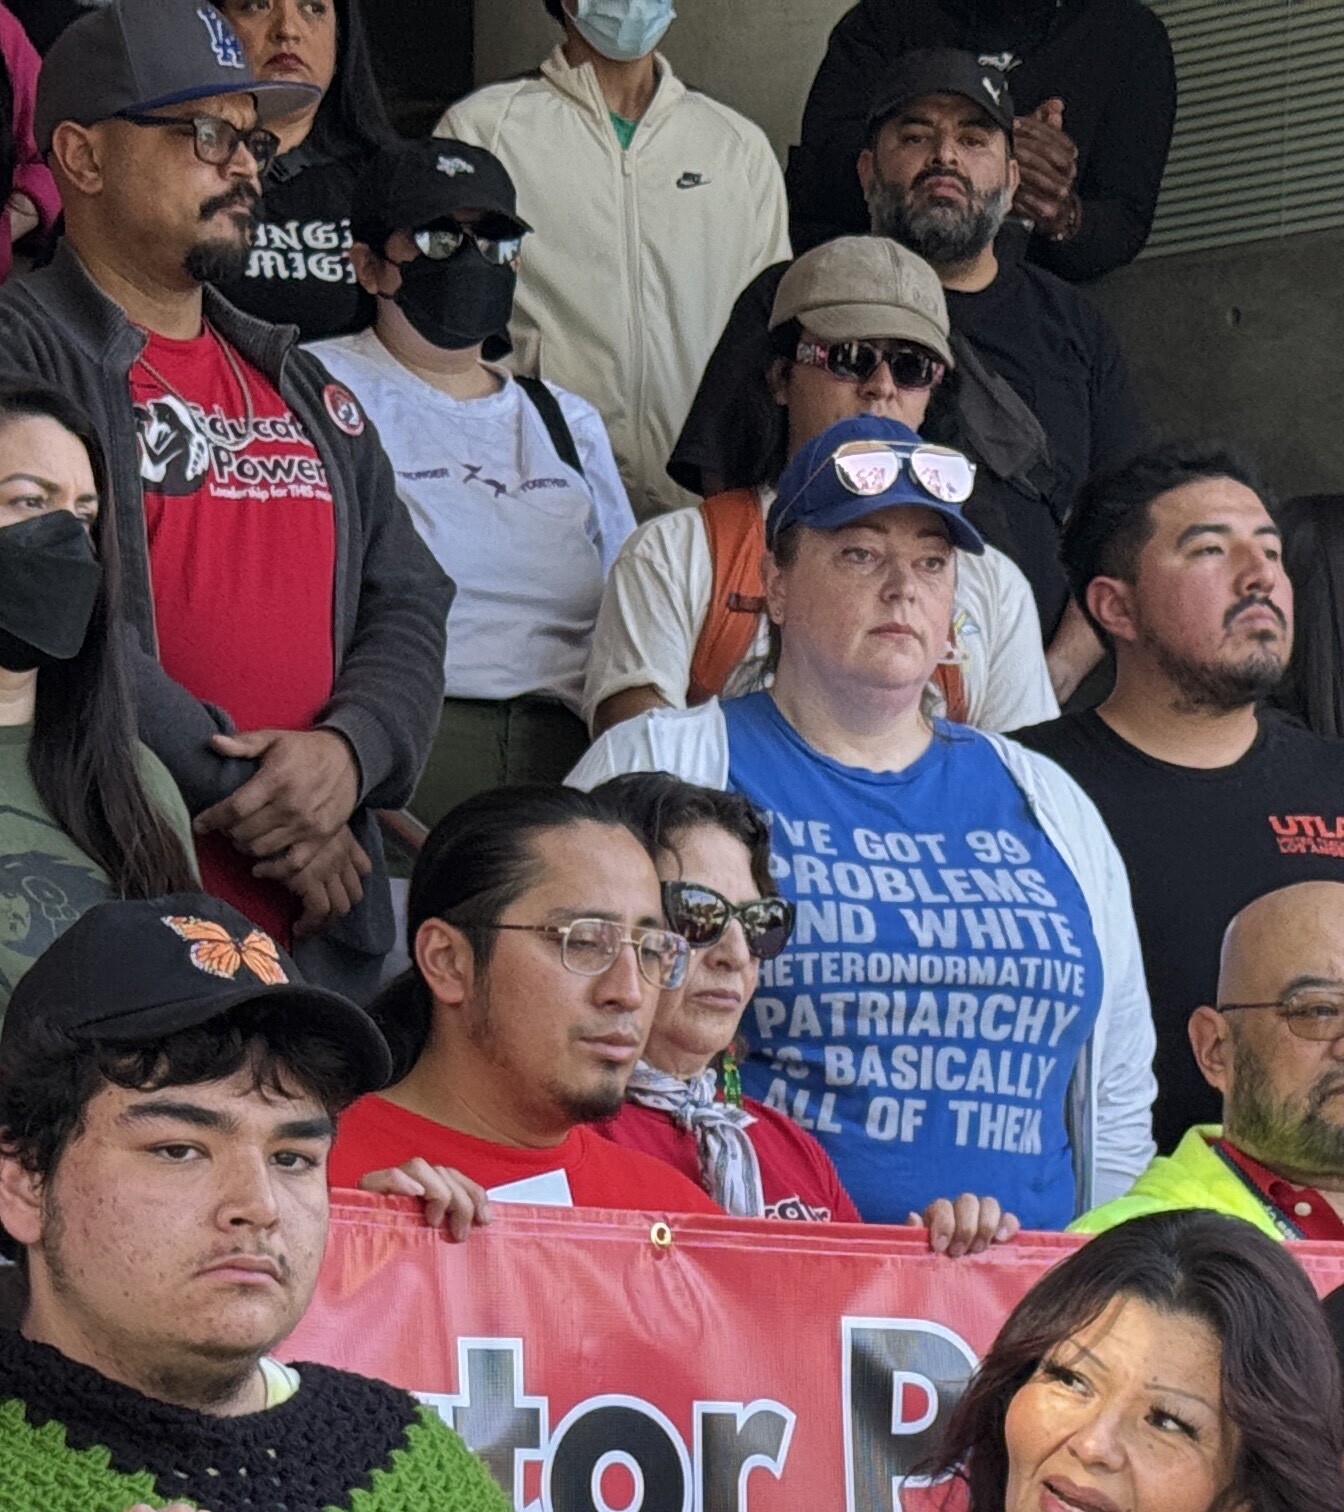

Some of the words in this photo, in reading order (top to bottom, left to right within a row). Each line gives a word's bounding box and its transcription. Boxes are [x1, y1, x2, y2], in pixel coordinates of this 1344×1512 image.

[853, 828, 947, 864] GOT
[965, 829, 1032, 865] 99
[786, 901, 877, 946] ND
[899, 906, 1083, 957] WHITE
[757, 953, 1086, 998] HETERONORMATIVE
[756, 991, 1080, 1047] PATRIARCHY
[824, 1044, 1056, 1100] BASICALLY
[763, 1078, 842, 1134] ALL
[865, 1097, 927, 1143] OF
[948, 1100, 1042, 1155] THEM
